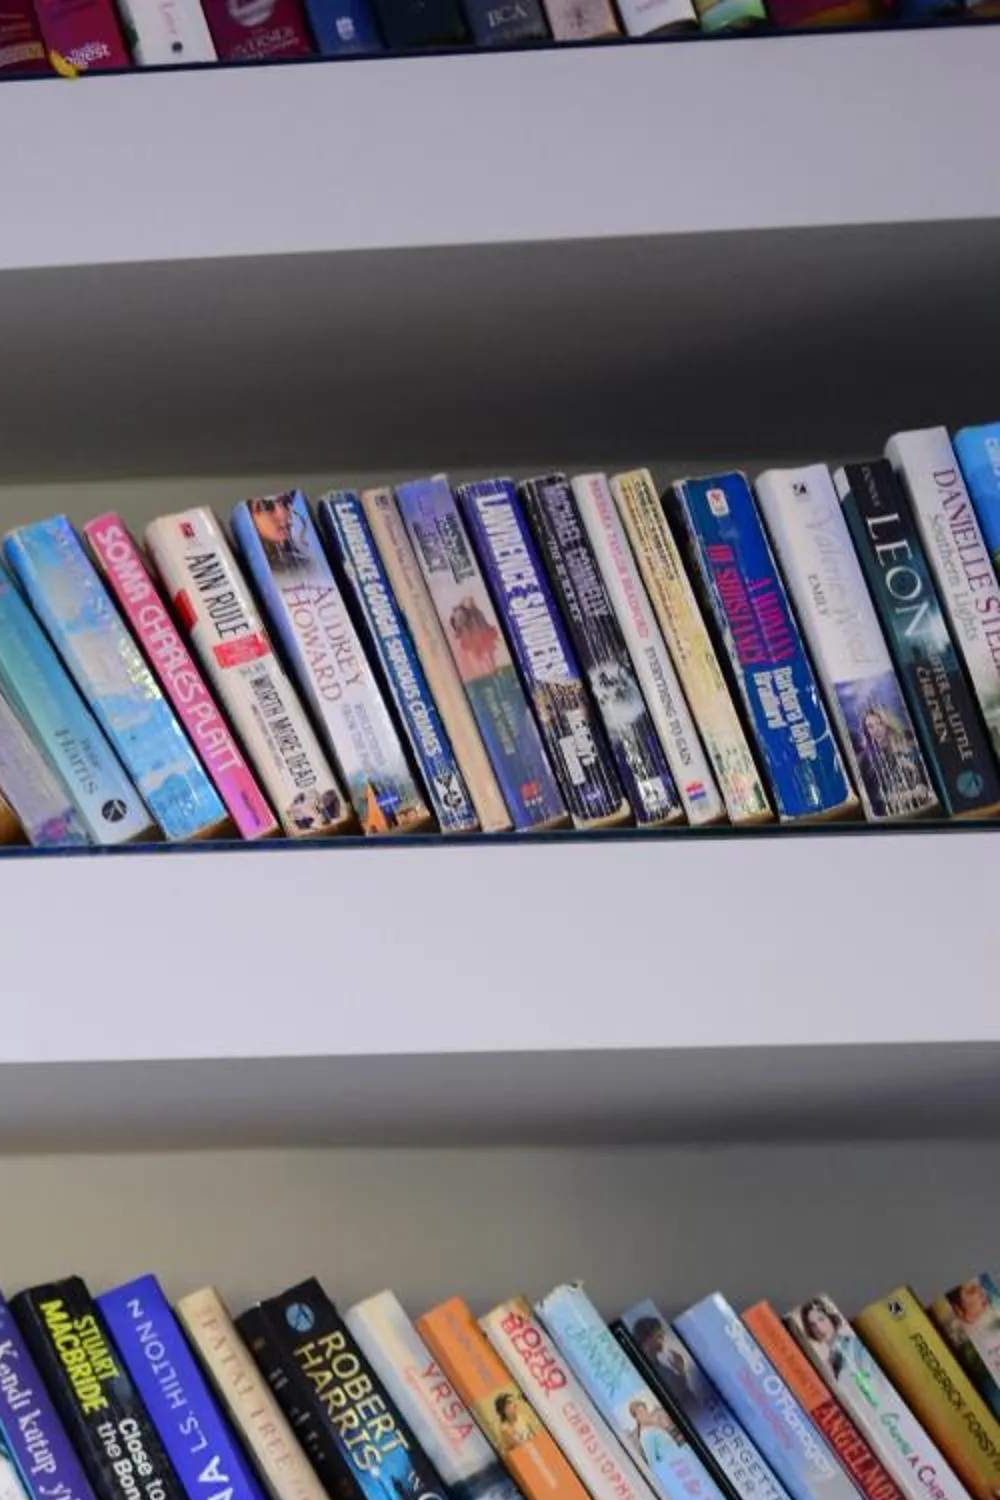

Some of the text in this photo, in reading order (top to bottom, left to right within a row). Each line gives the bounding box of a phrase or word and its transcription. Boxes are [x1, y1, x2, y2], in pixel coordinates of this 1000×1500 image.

[335, 501, 381, 581] LAURENCE
[475, 493, 539, 593] LAWRENCE
[933, 469, 994, 592] DANIELLE
[186, 552, 251, 641] ANN RULE
[362, 578, 399, 638] GOUGH
[807, 573, 829, 617] EMILY
[865, 511, 930, 638] LEON
[95, 524, 242, 773] SOMA CHARLES PLATT
[283, 584, 343, 703] HOWARD
[303, 583, 367, 689] AUDREY
[509, 591, 570, 682] SANDERS
[953, 591, 979, 643] Lights
[380, 633, 422, 700] SERIOUS
[753, 671, 783, 728] Bradford
[770, 665, 803, 722] Barbara
[54, 728, 98, 795] Harris
[249, 669, 318, 789] WORTH MORE DEAD
[404, 698, 443, 757] CRIMES
[39, 1299, 109, 1415] MACBRIDE
[74, 1313, 120, 1381] STUART
[135, 1321, 208, 1454] L.S. HILTON
[293, 1343, 383, 1481] HARRIS
[317, 1329, 409, 1452] ROBERT
[421, 1360, 475, 1442] YRSA
[909, 1332, 1000, 1472] FREDERICK FORSY
[18, 1409, 57, 1476] kutup
[97, 1420, 122, 1458] the
[117, 1416, 154, 1478] Close
[702, 1426, 756, 1496] HEYER
